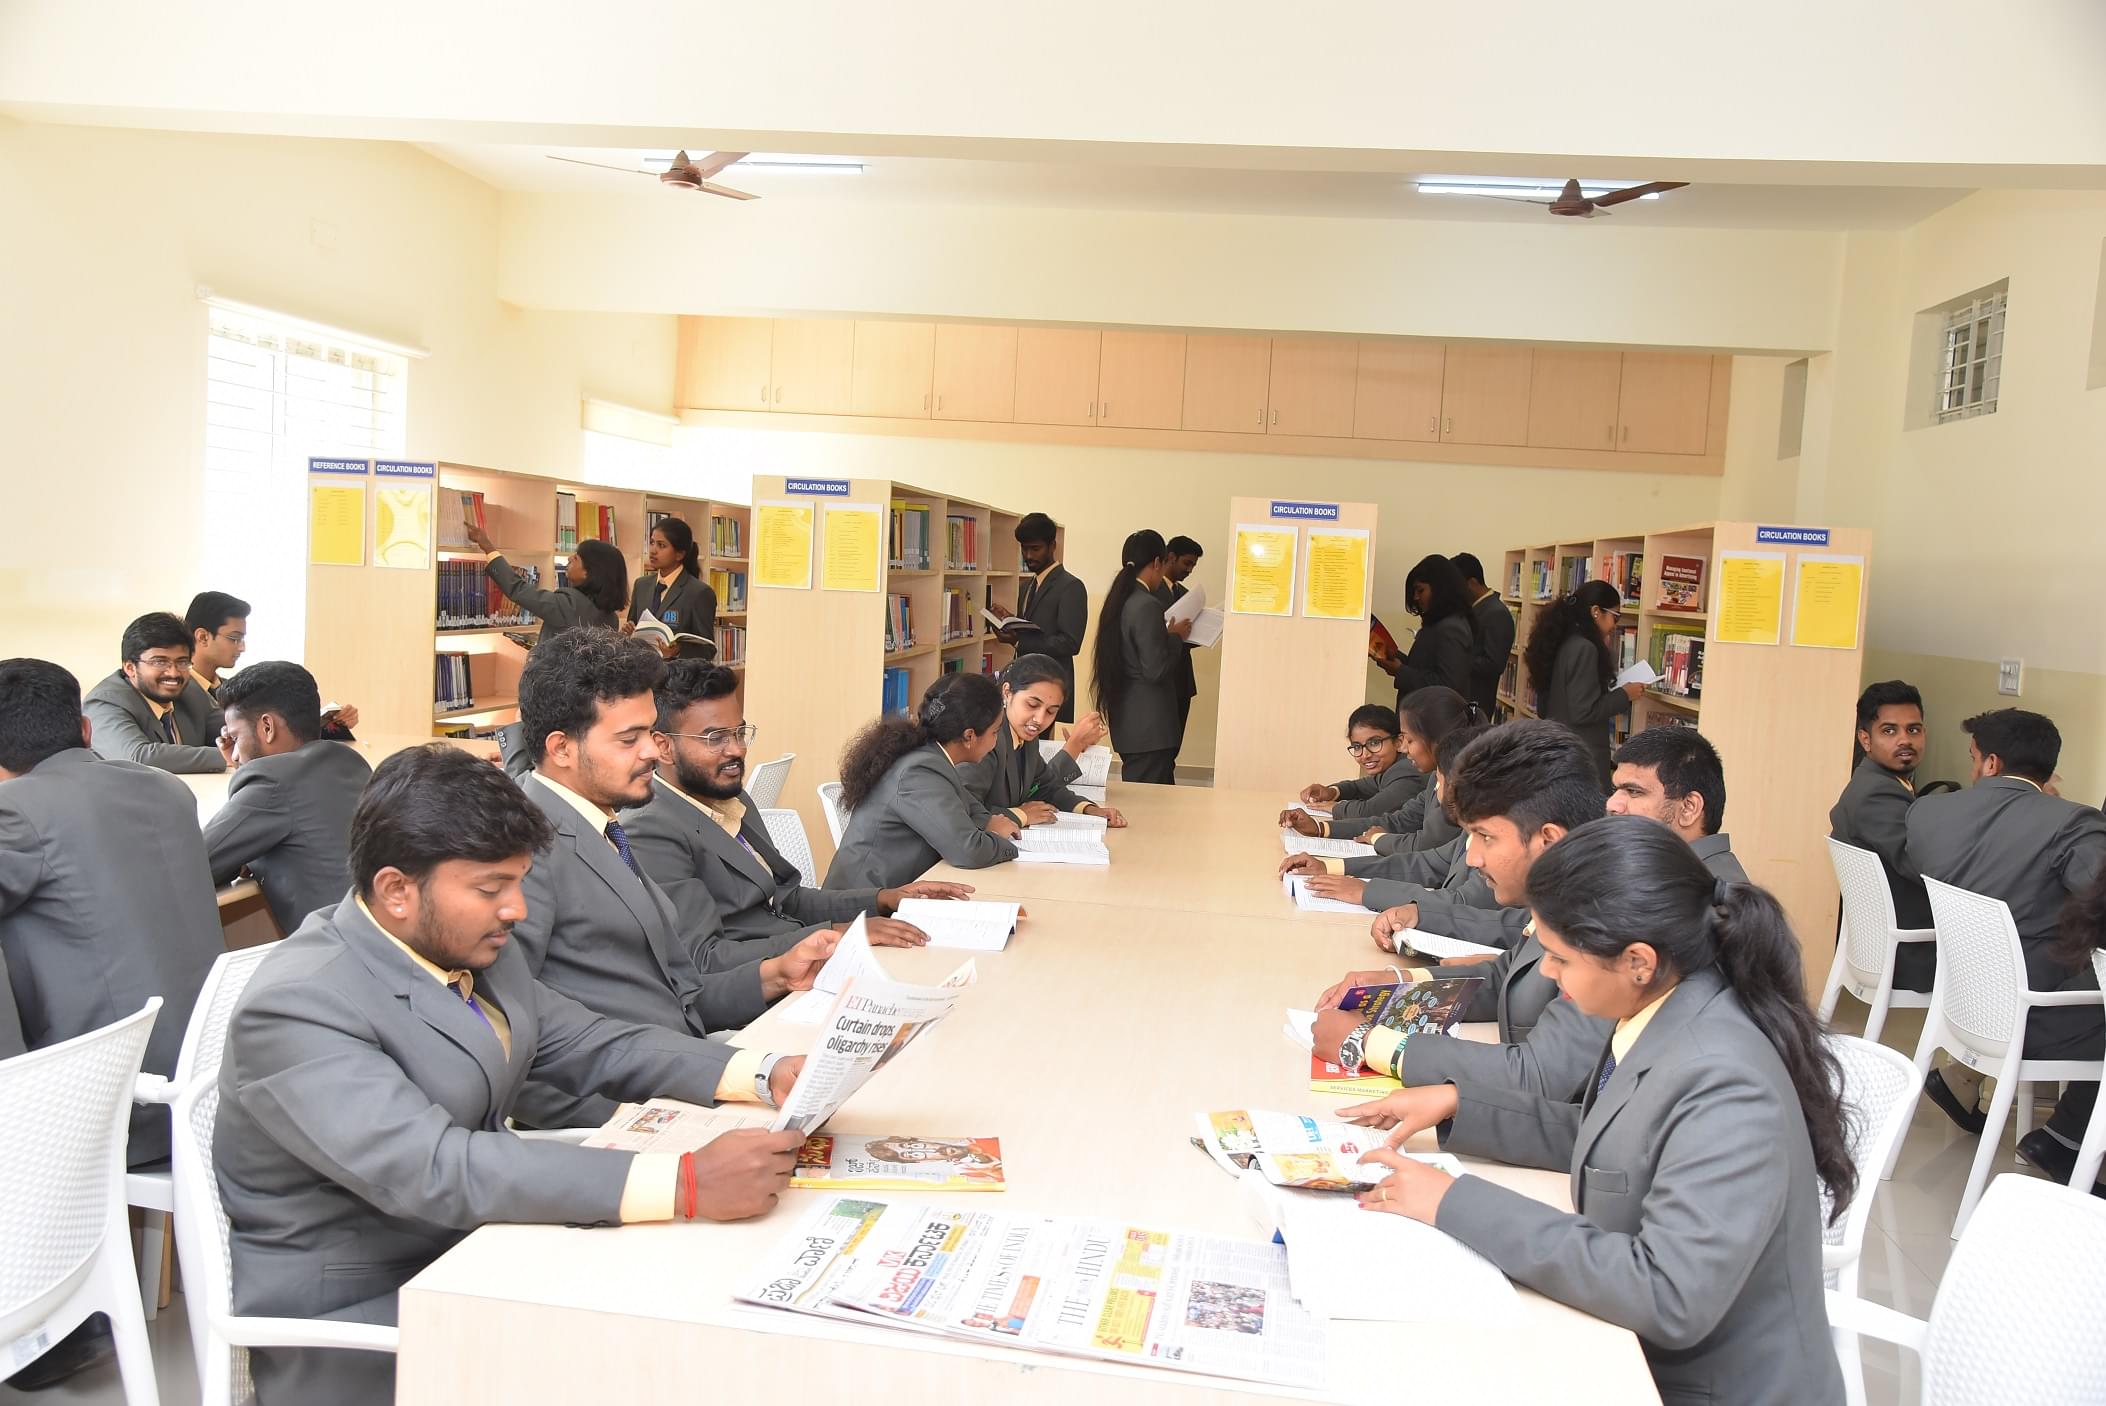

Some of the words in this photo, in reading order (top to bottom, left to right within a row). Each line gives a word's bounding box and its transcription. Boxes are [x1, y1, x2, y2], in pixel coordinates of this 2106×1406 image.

[312, 461, 345, 470] REFERENCE
[346, 463, 366, 471] BOOKS
[376, 464, 412, 473] CIRCULATION
[414, 466, 432, 474] BOOKS
[788, 482, 825, 491] CIRCULATION
[826, 484, 847, 492] BOOKS
[1273, 506, 1313, 515] CIRCULATION
[1314, 508, 1336, 516] BOOKS
[1759, 530, 1802, 540] CIRCULATION
[1802, 532, 1826, 542] BOOKS
[836, 1015, 872, 1035] Curtain
[826, 1035, 872, 1056] oligarchy
[1073, 1233, 1111, 1277] HINDU
[981, 1271, 1011, 1301] TIMES
[1001, 1227, 1030, 1252] INDIA
[1056, 1299, 1091, 1325] THE
